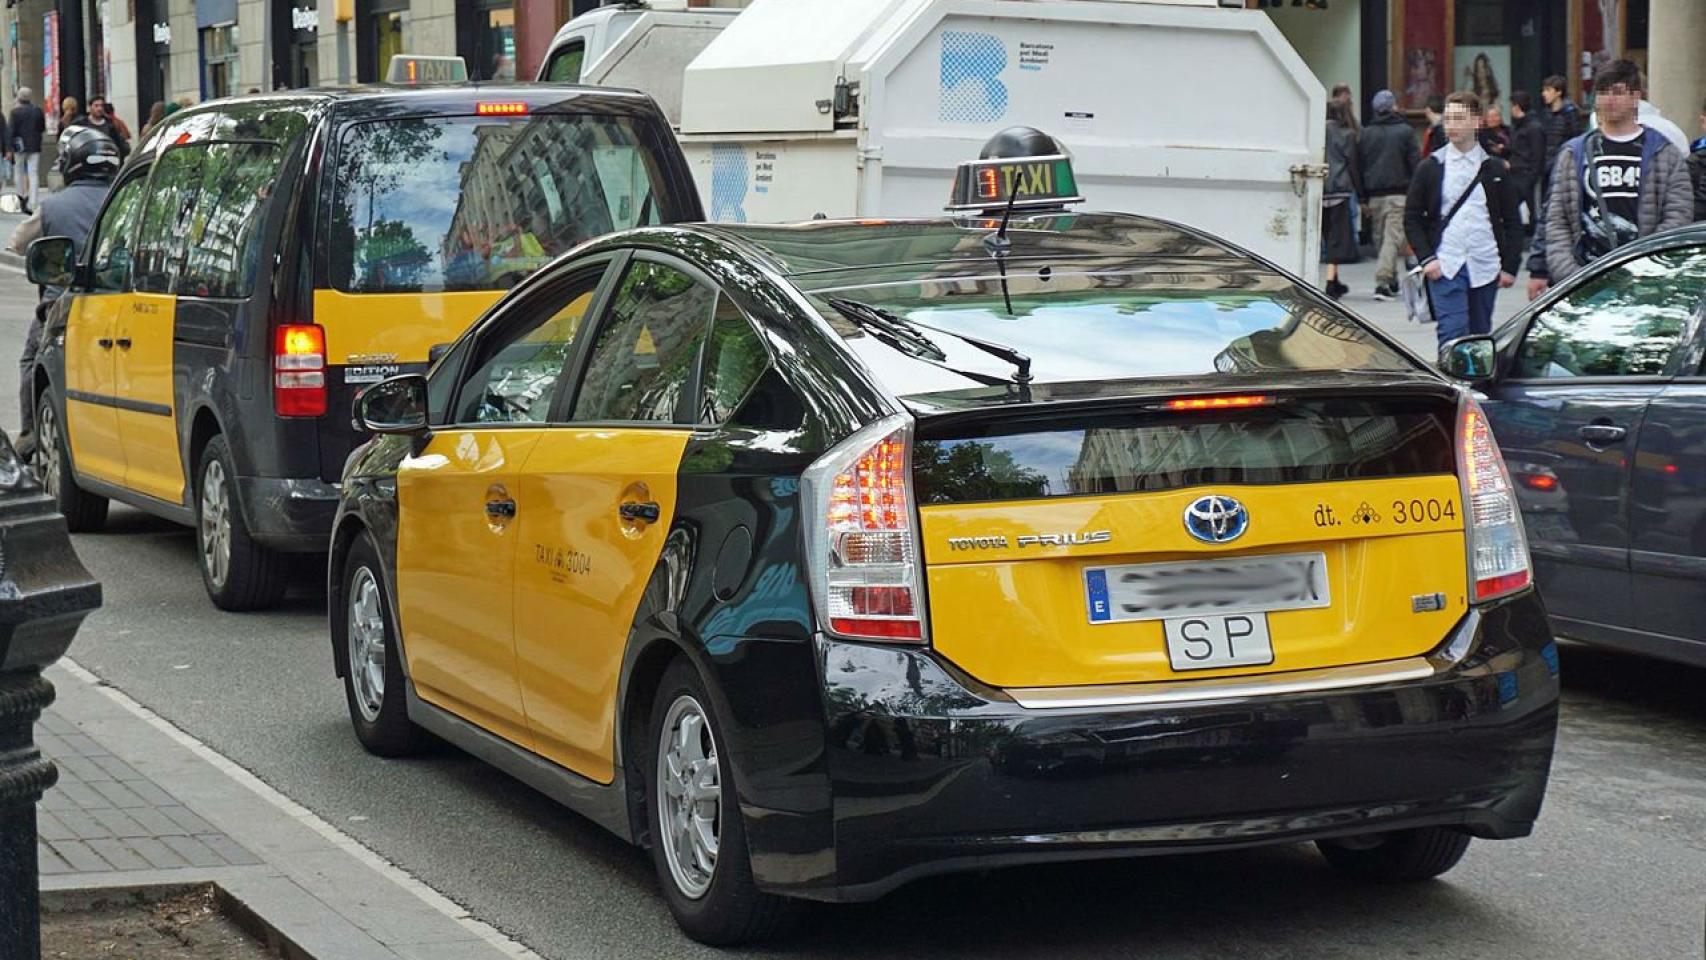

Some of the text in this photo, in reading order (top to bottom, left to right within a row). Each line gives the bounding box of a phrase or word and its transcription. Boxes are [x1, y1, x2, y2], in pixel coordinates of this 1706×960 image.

[419, 61, 451, 80] TAXI
[1001, 163, 1052, 197] TAXI
[1314, 499, 1456, 527] dt. 3004
[948, 529, 1111, 551] TOYOTA PRIUS
[536, 544, 591, 576] TAXI 3004
[1095, 600, 1105, 613] E
